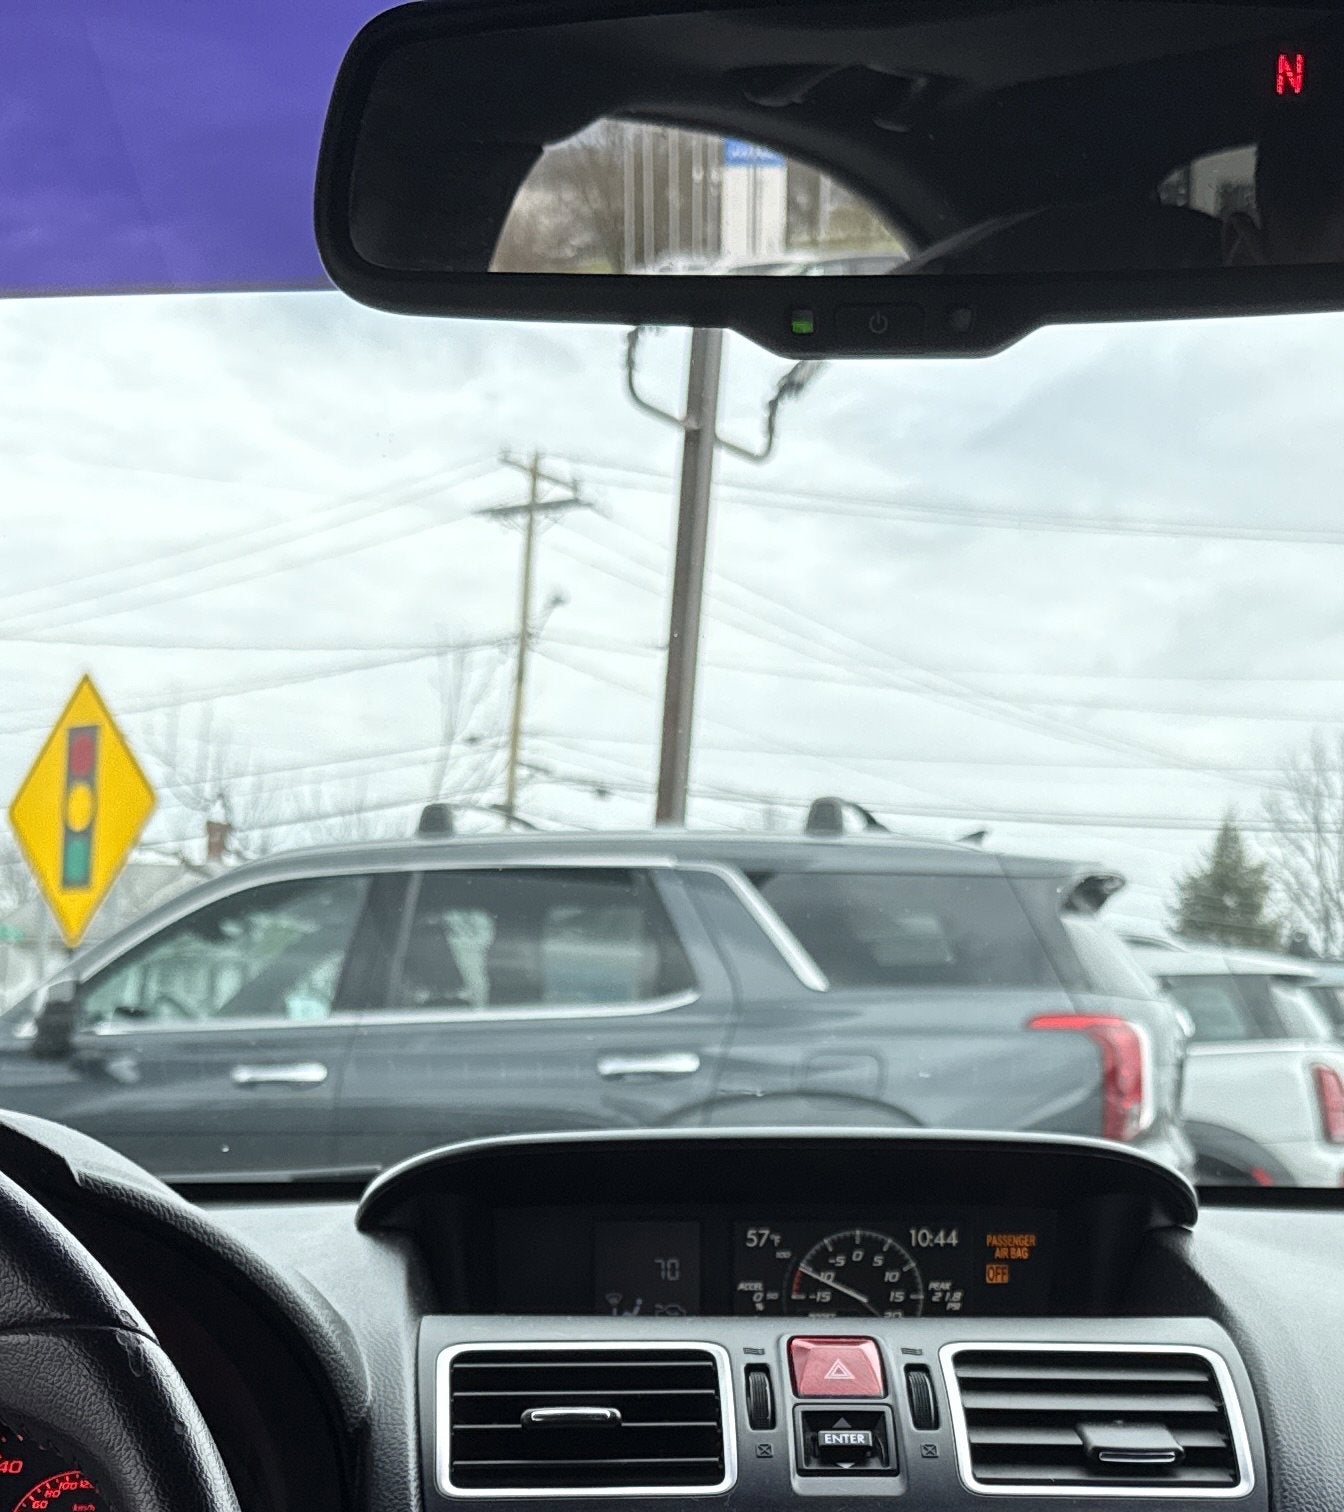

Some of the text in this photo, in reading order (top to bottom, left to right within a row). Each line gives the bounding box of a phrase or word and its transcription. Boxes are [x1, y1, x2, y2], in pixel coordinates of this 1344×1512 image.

[1276, 53, 1304, 95] N
[909, 1228, 959, 1248] 10:44
[986, 1233, 1036, 1247] PASSENGER
[1010, 1247, 1029, 1259] BAG
[654, 1259, 680, 1280] 70
[986, 1265, 1008, 1282] OFF
[884, 1271, 901, 1283] 10
[889, 1291, 906, 1303] 15
[824, 1434, 865, 1444] ENTER
